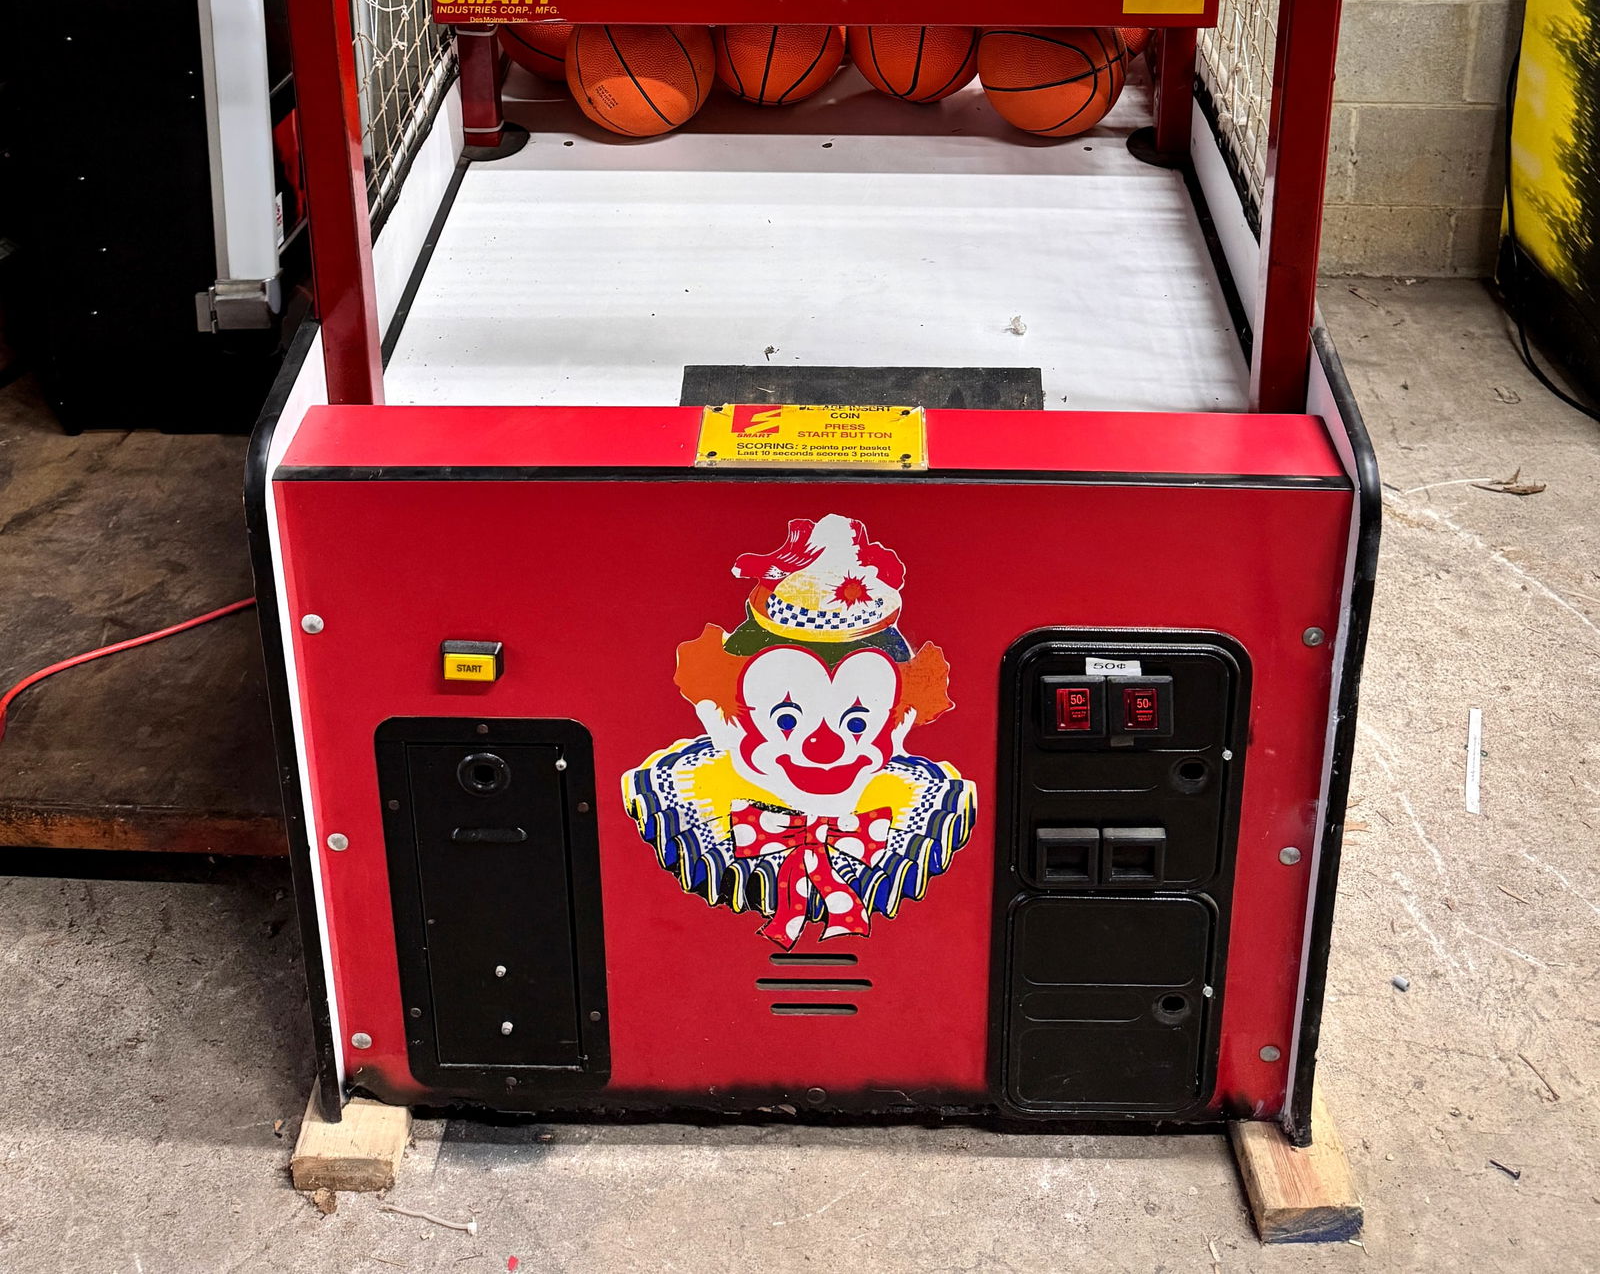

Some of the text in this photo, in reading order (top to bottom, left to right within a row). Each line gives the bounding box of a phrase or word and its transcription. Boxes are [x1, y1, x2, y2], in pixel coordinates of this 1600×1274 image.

[436, 5, 497, 14] INDUSTRIES
[535, 5, 560, 14] MFG.
[840, 431, 892, 439] BUTTON
[736, 442, 798, 450] SCORING:
[457, 664, 482, 673] START
[1093, 662, 1126, 670] 50¢
